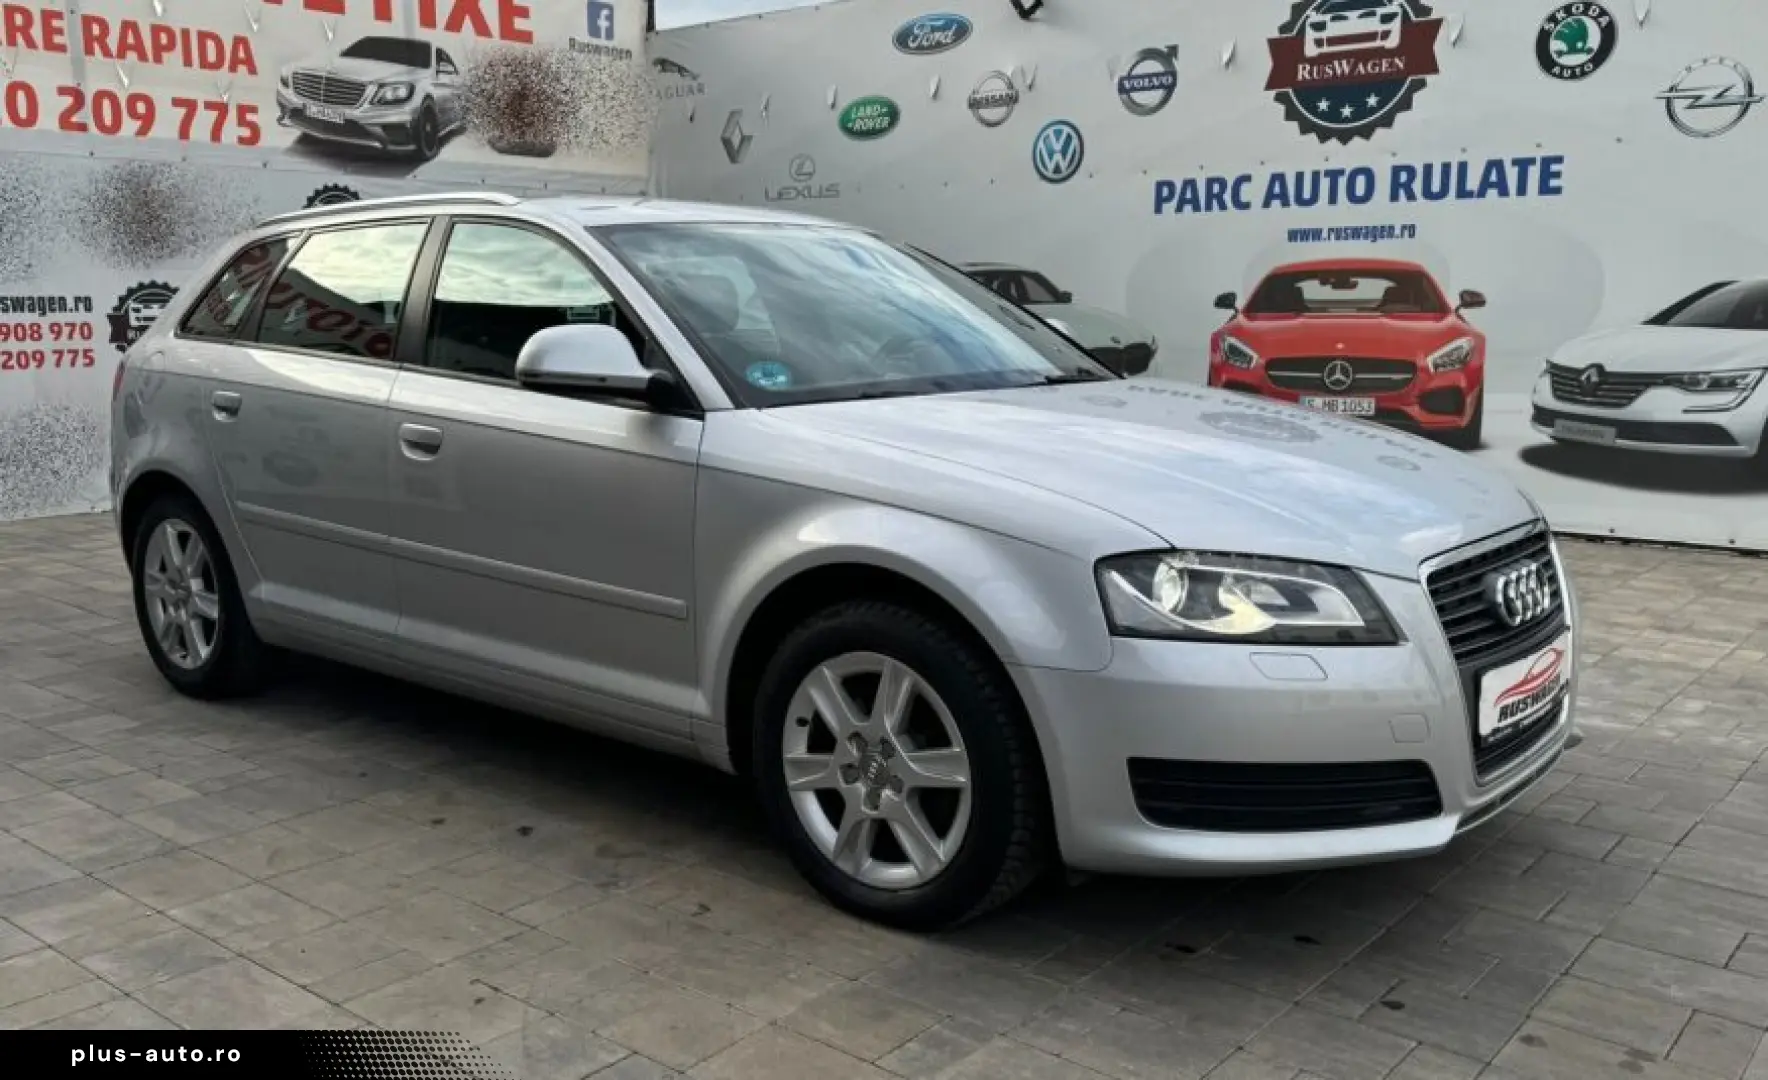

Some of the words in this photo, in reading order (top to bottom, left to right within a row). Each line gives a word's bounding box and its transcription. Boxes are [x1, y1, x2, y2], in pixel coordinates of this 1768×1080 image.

[0, 4, 67, 53] RE
[81, 14, 258, 76] RAPIDA
[1123, 76, 1173, 89] VOLVO
[56, 85, 155, 138] 209
[171, 96, 262, 147] 775
[764, 183, 841, 203] LEXUS
[1153, 174, 1252, 215] PARC
[1261, 166, 1376, 209] AUTO
[1389, 155, 1565, 203] RULATE
[1287, 223, 1416, 243] www.ruswagen.ro
[0, 322, 43, 342] 908
[48, 322, 93, 341] 970
[0, 350, 45, 370] 209
[52, 348, 95, 368] 775
